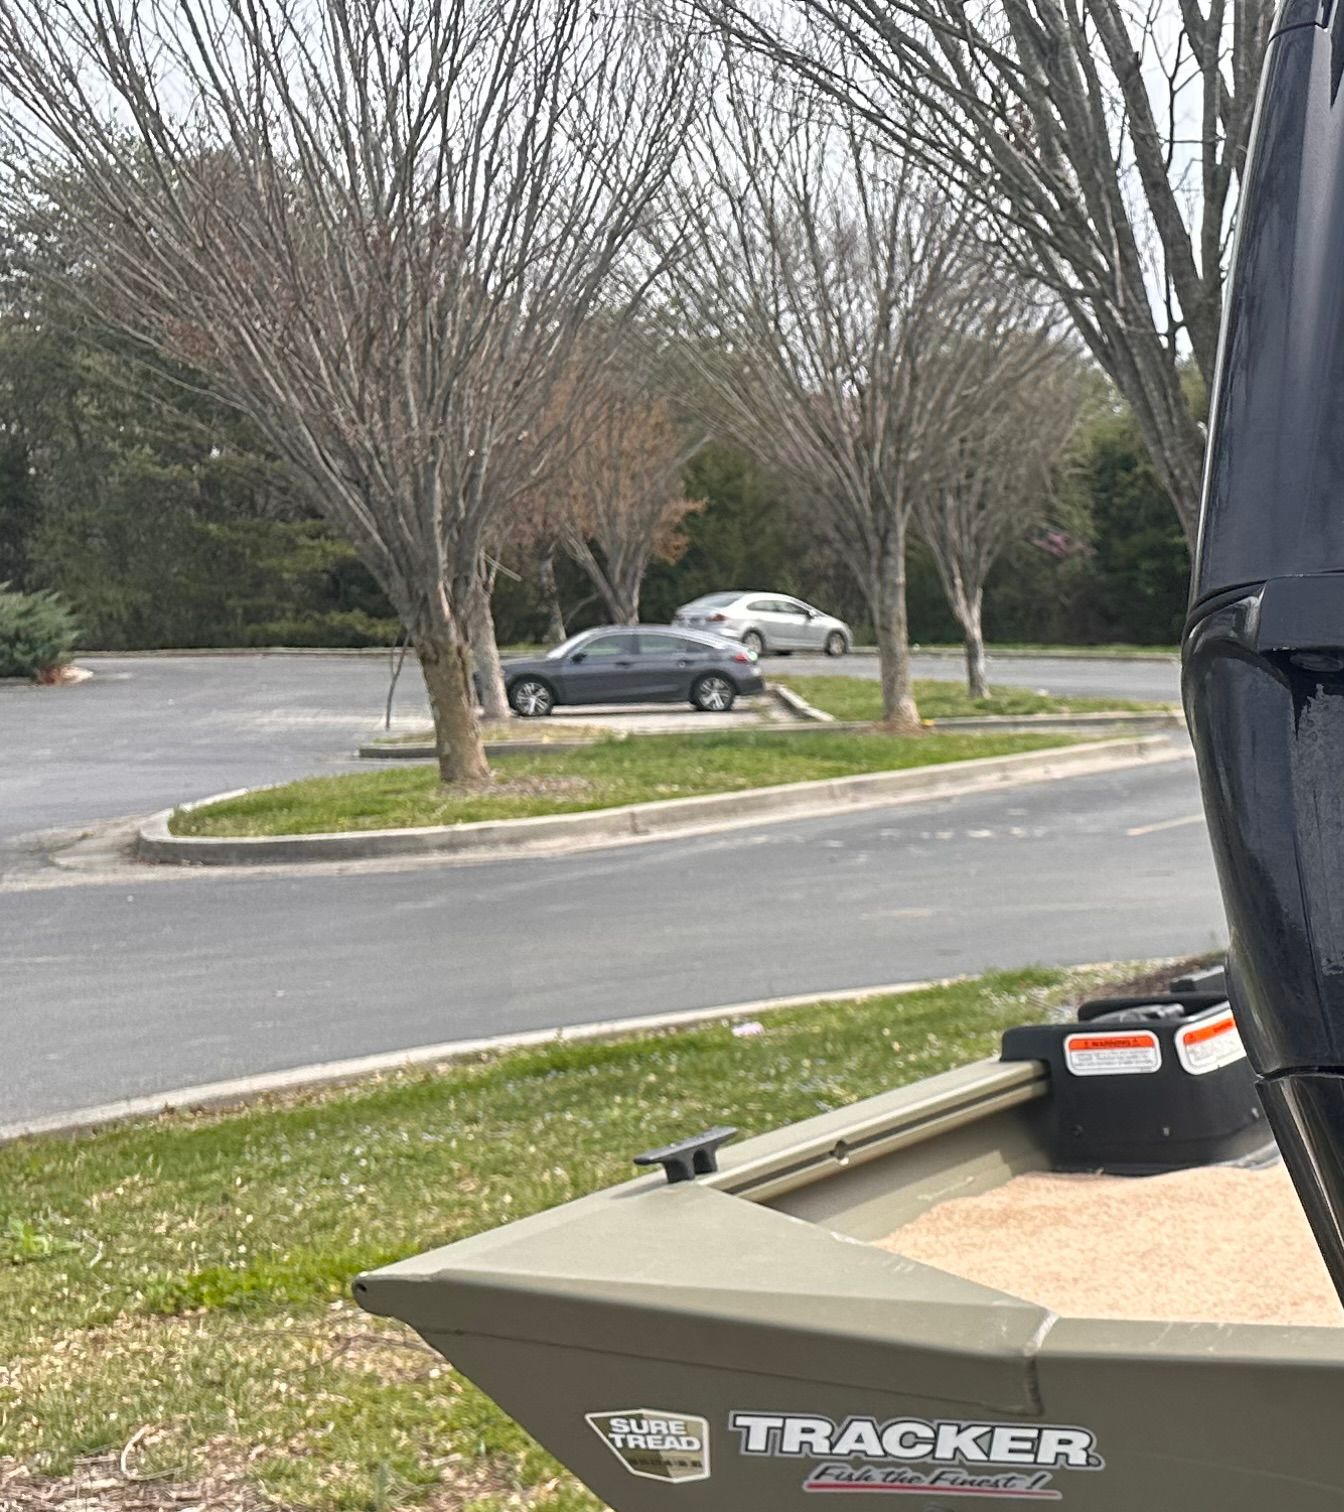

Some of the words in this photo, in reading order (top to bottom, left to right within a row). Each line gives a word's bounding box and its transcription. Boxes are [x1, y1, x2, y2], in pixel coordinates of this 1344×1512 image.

[609, 1418, 687, 1435] SURE
[608, 1433, 701, 1451] TREAD
[732, 1414, 1093, 1467] TRACKER
[813, 1465, 872, 1483] Fish
[878, 1468, 922, 1485] the
